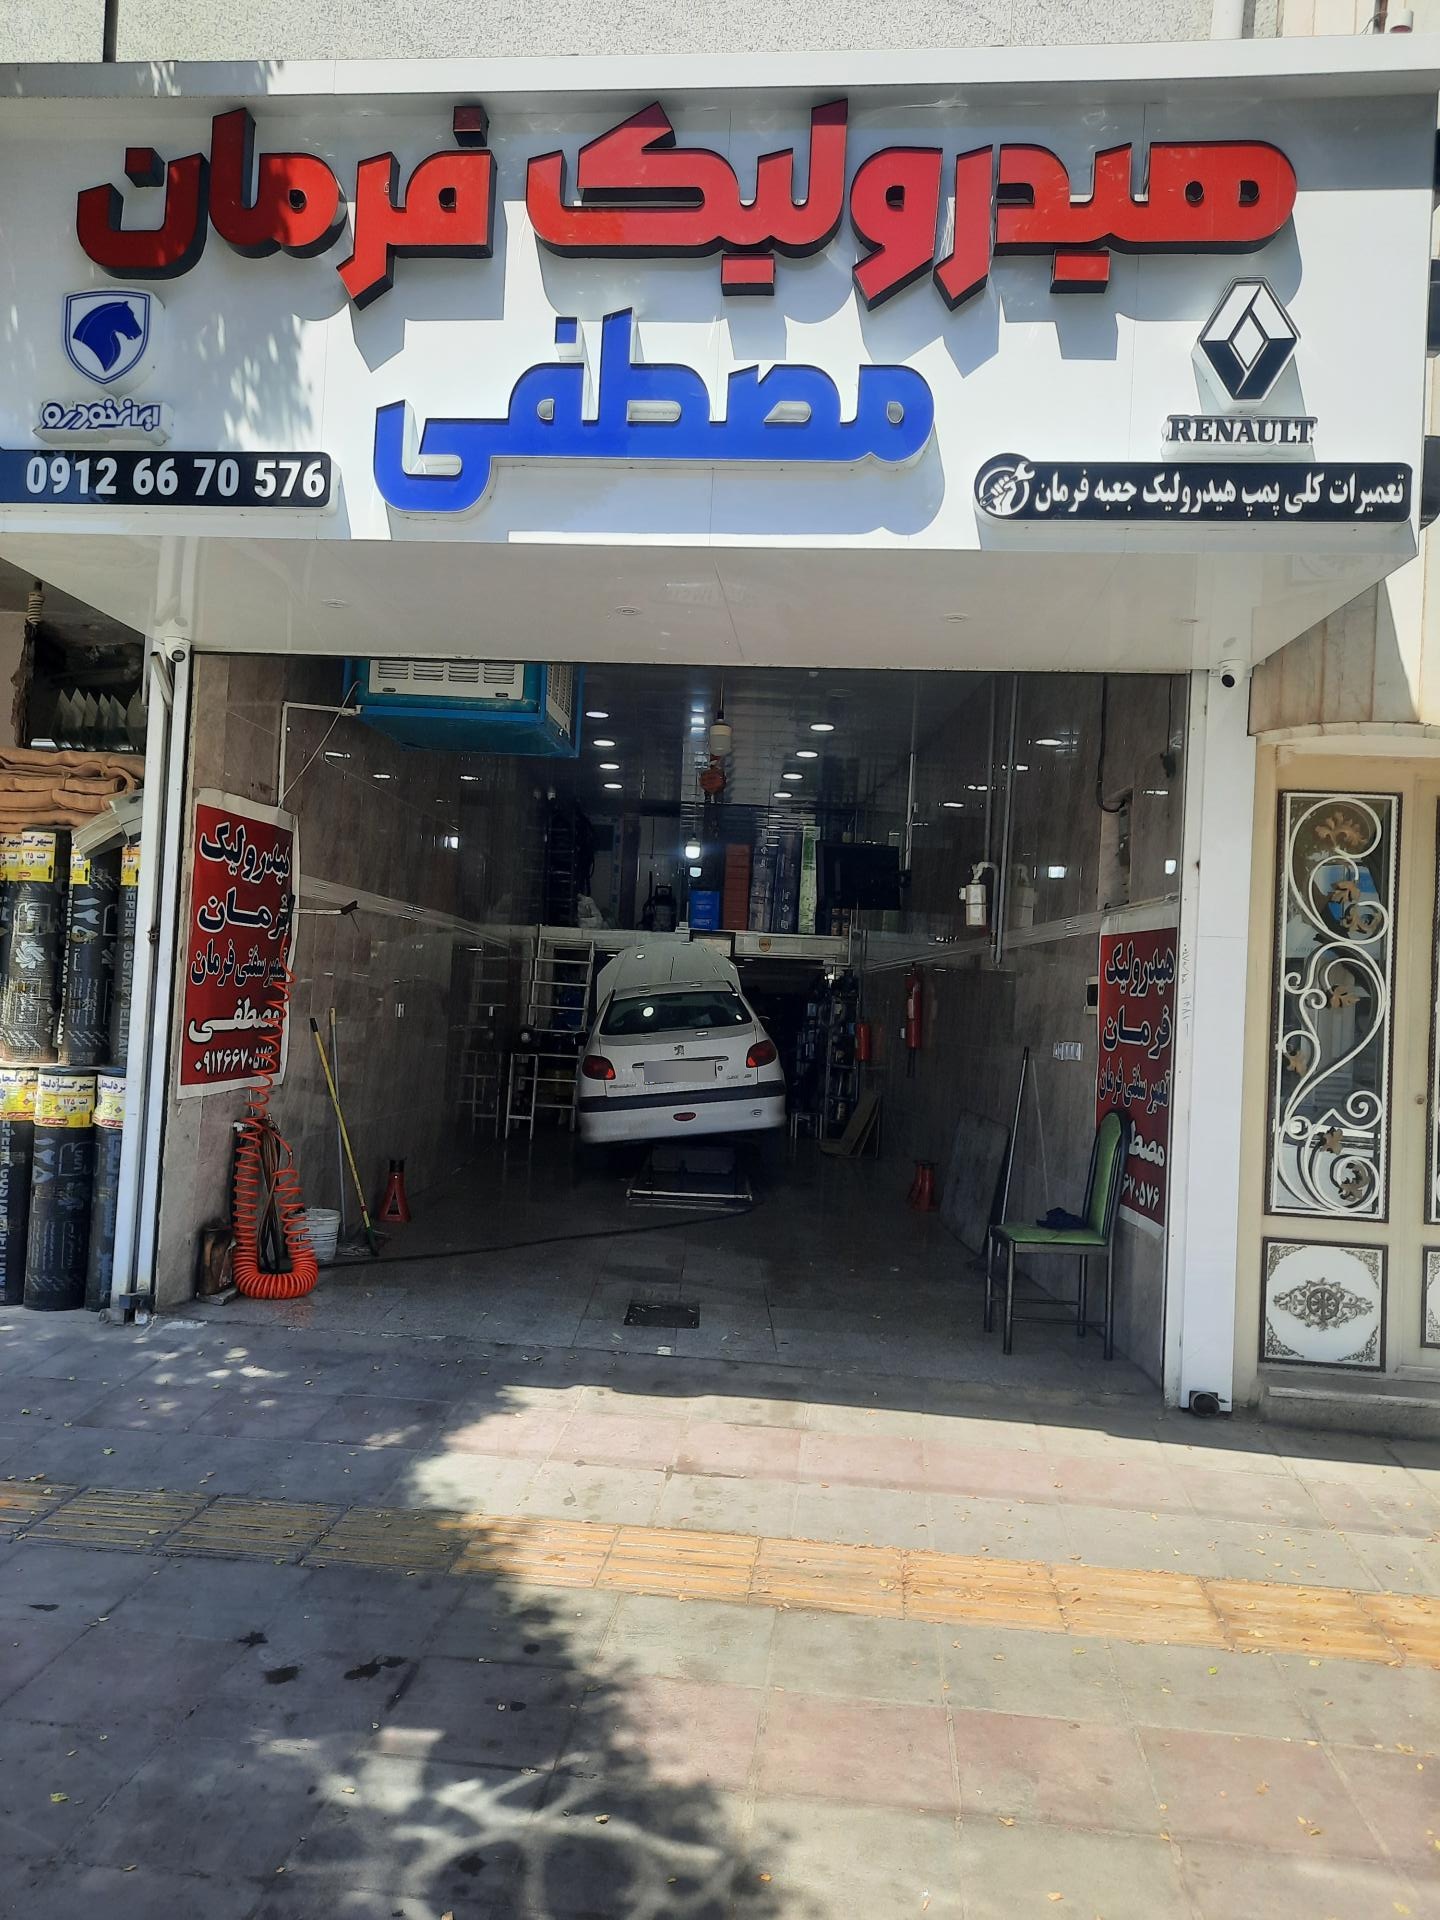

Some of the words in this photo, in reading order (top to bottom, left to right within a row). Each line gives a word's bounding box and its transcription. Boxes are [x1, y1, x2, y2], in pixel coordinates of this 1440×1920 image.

[76, 105, 498, 310] فرمان
[526, 98, 1298, 311] هیدرولیک
[373, 306, 935, 512] مصطفی
[1167, 417, 1314, 445] RENAULT
[26, 456, 118, 495] 0912
[132, 457, 179, 496] 66
[193, 458, 241, 497] 70
[253, 459, 326, 498] 576
[1034, 469, 1090, 513] فرمان
[1094, 475, 1138, 511] جعبه
[1142, 472, 1235, 514] هیدرولیک
[1284, 472, 1326, 513] کلی
[1328, 472, 1405, 514] تعمیرات
[1240, 482, 1280, 518] پمپ
[190, 938, 235, 987] فرمان
[1105, 940, 1176, 997] هیدرولیک
[1102, 1004, 1172, 1060] فرمان
[1098, 1056, 1124, 1104] فرمان
